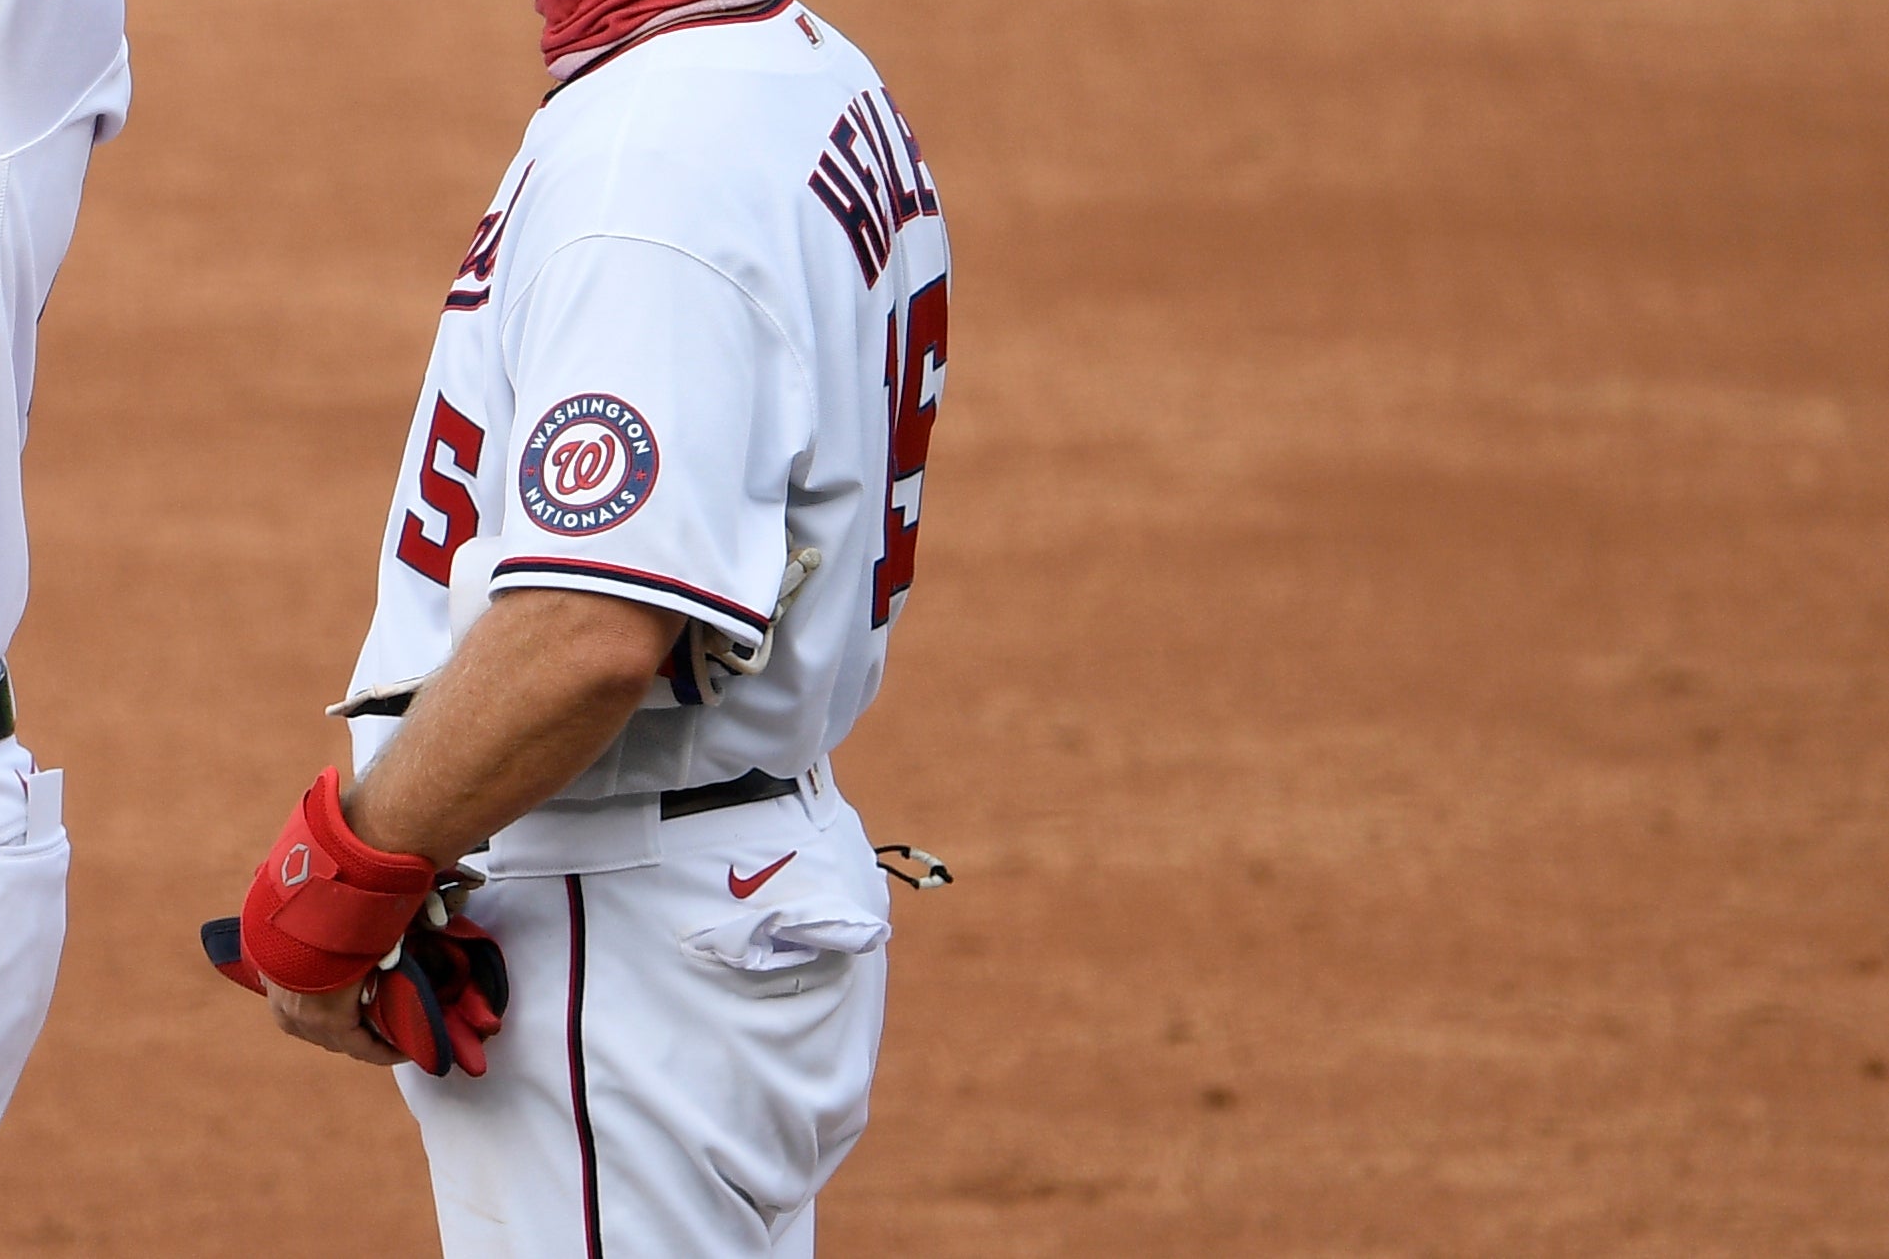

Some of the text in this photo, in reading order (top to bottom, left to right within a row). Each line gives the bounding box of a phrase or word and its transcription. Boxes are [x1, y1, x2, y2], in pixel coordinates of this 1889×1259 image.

[530, 398, 651, 455] WASHINGTON
[552, 433, 616, 496] W
[525, 487, 637, 528] NATIONALS
